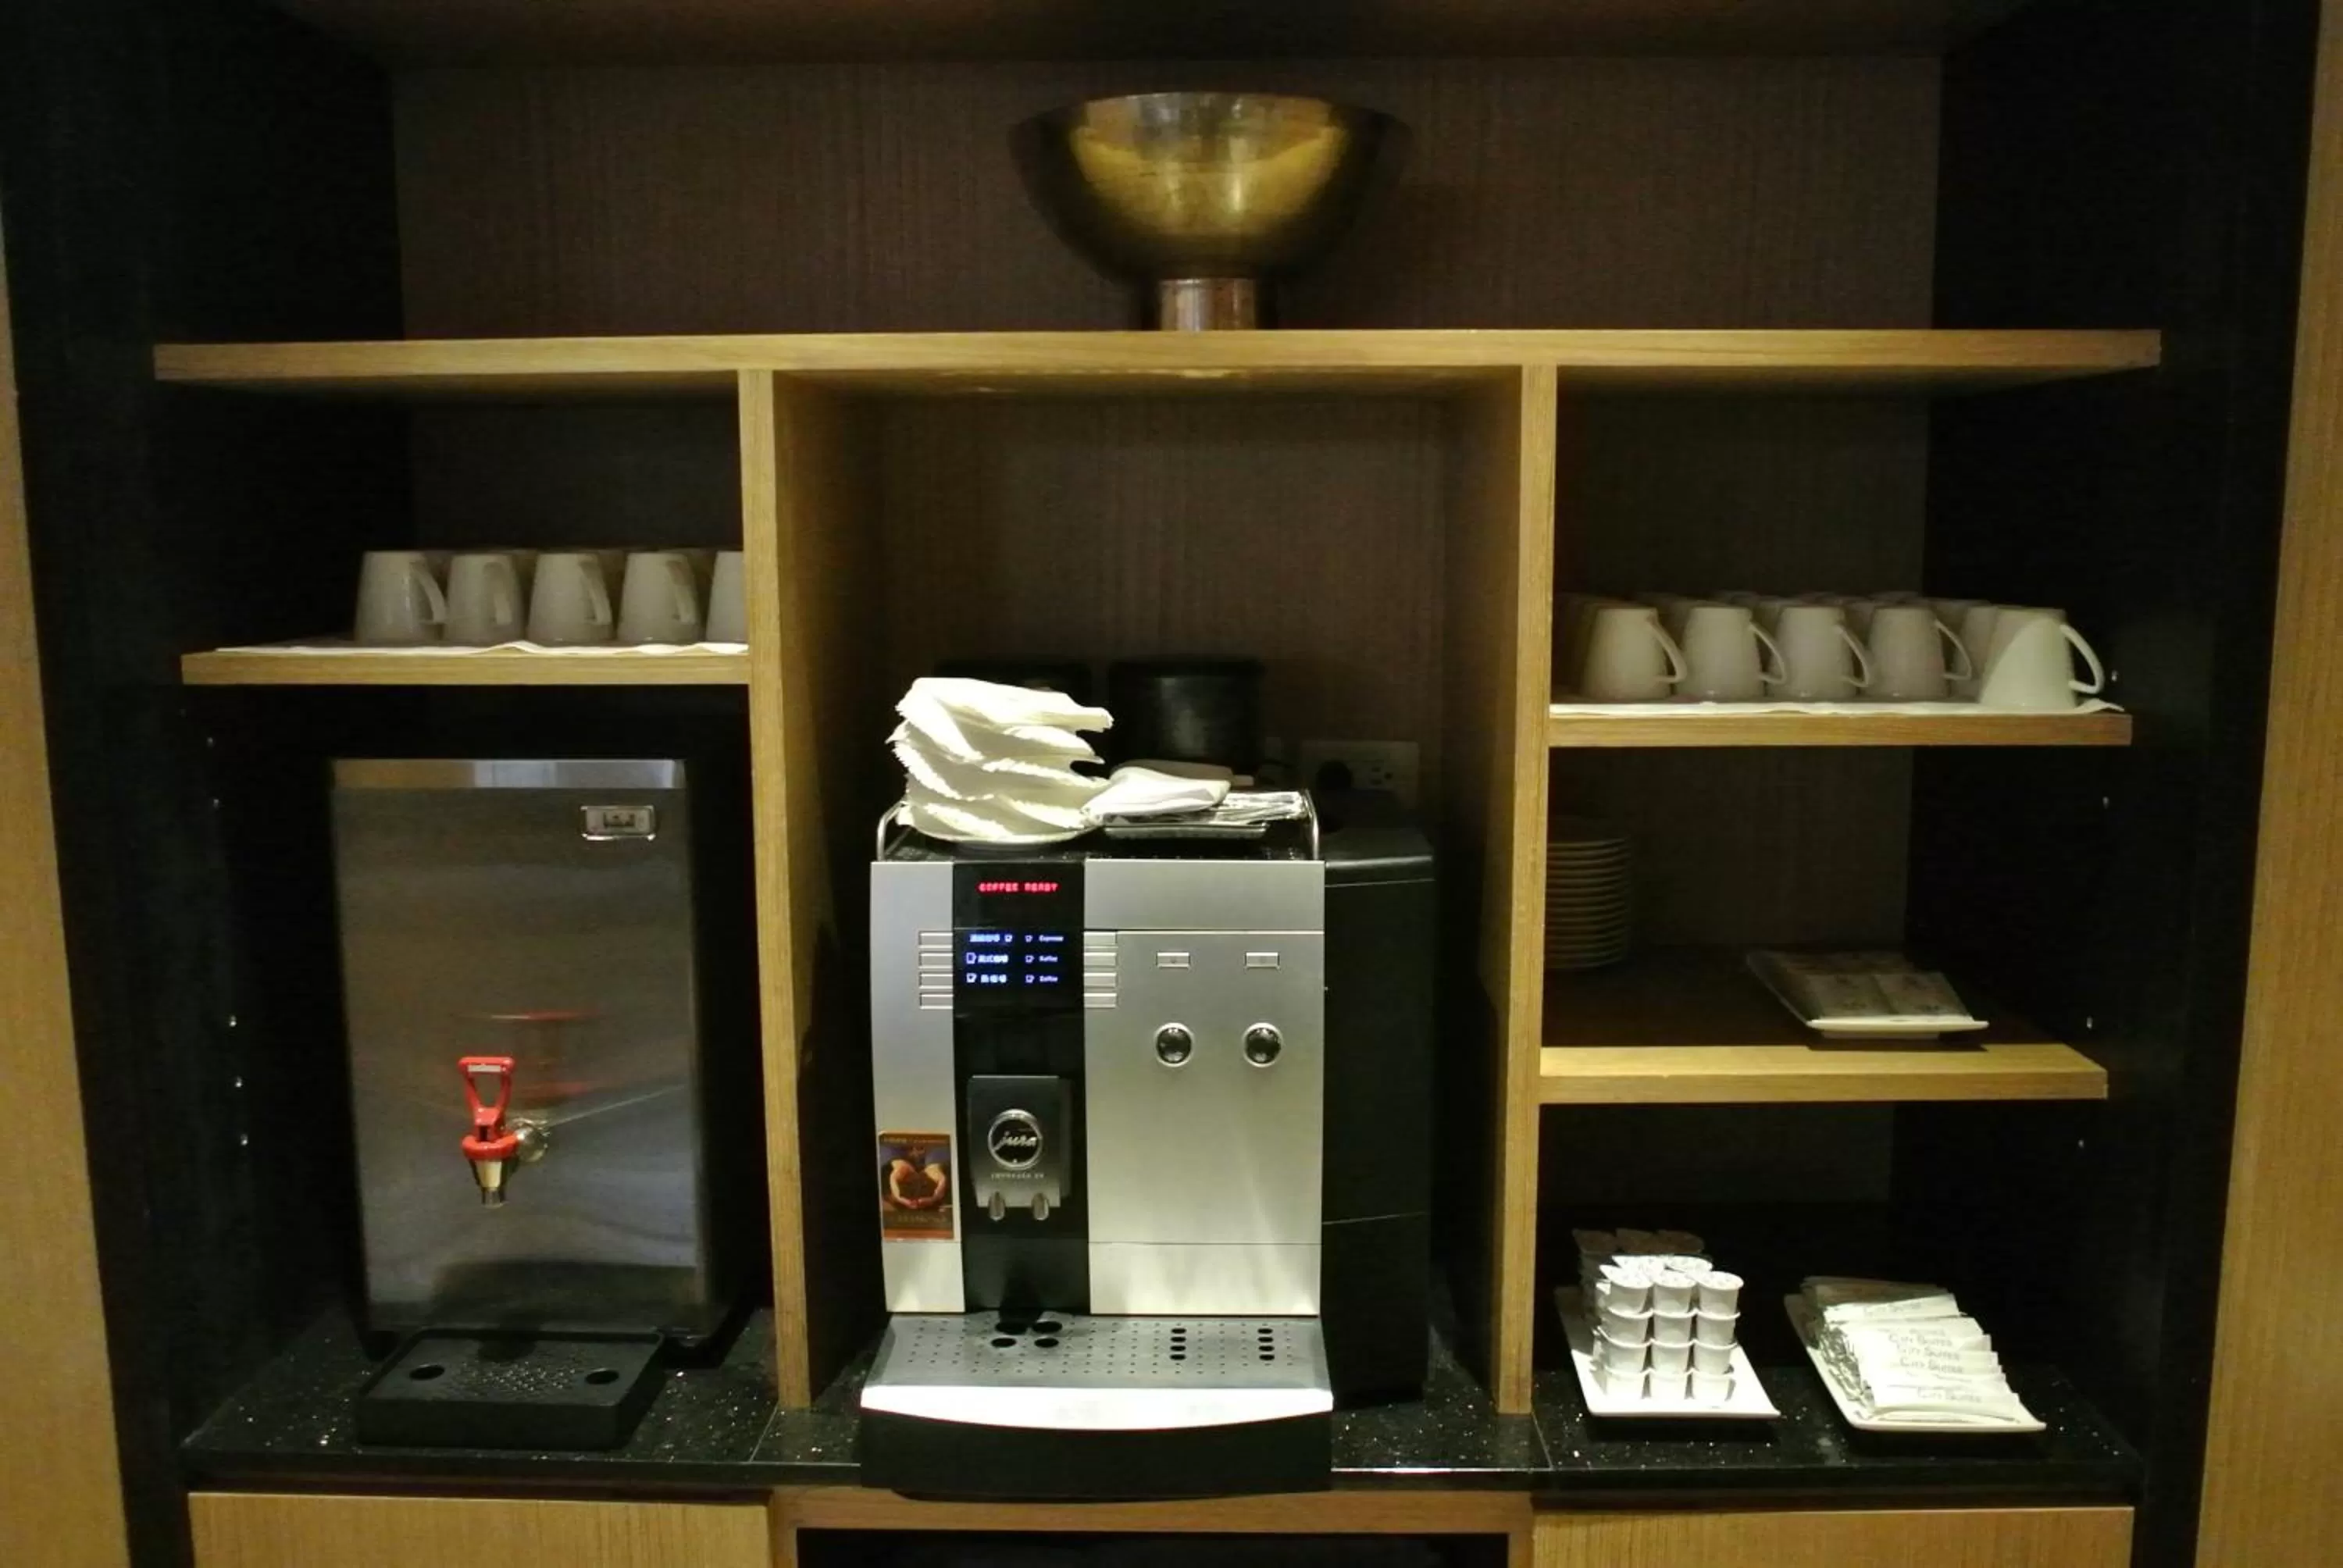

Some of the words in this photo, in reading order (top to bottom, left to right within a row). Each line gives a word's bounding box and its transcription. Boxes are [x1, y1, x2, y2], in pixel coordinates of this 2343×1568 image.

[978, 882, 1018, 893] COFFEE
[1024, 882, 1058, 893] READY
[993, 1130, 1037, 1150] jura
